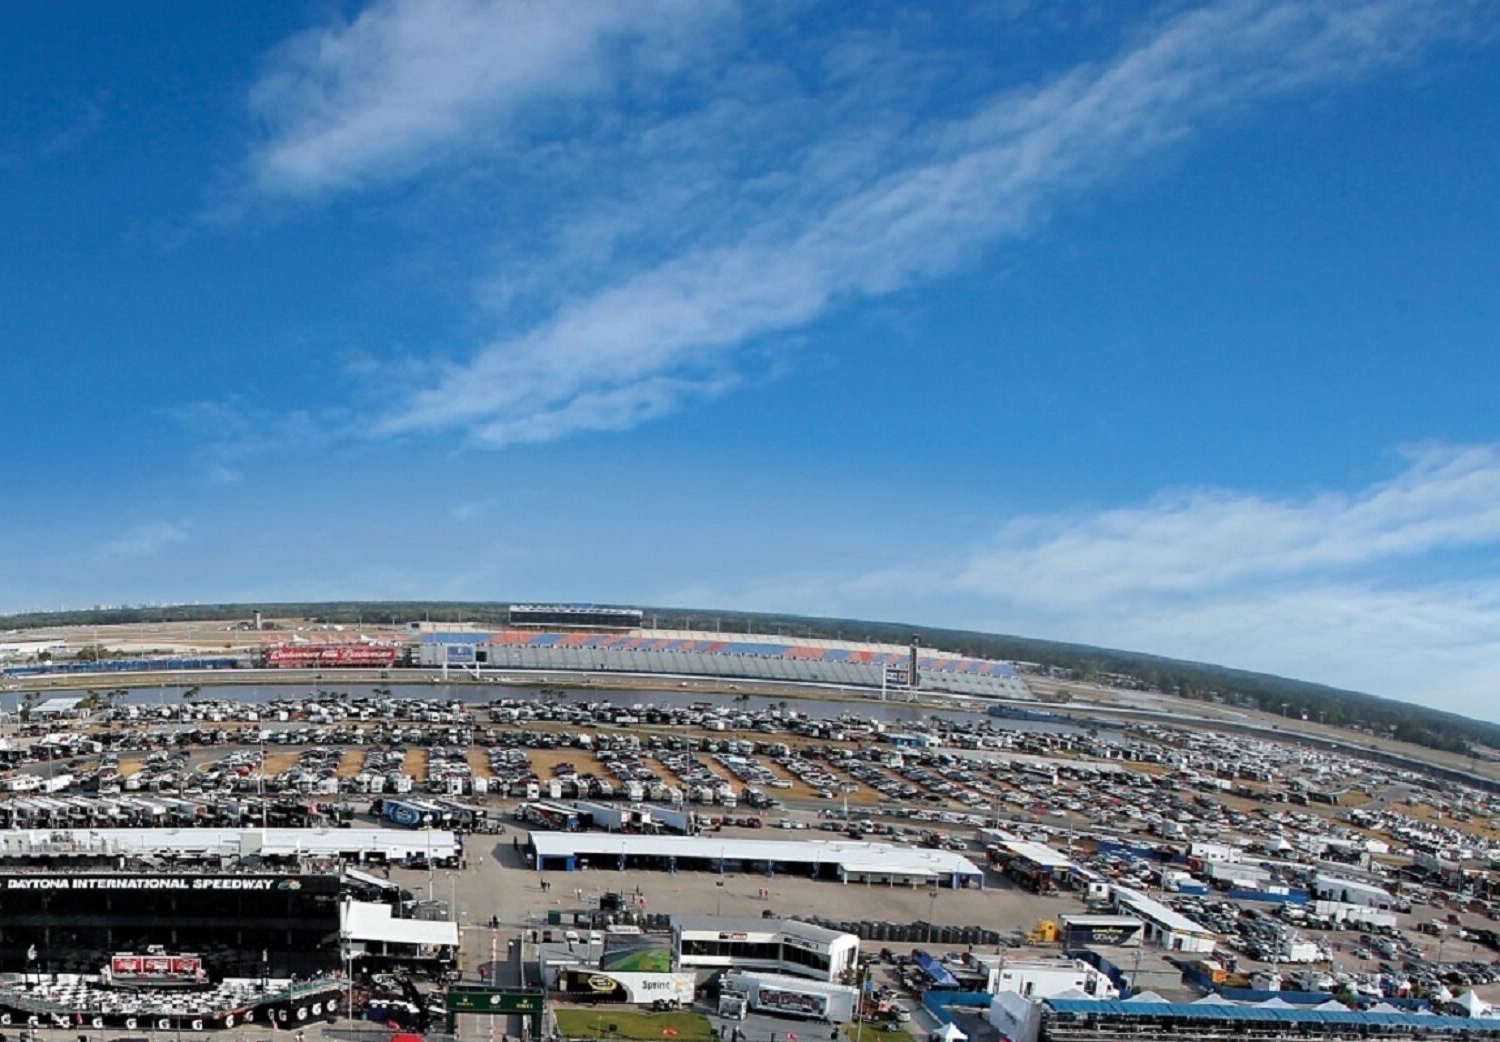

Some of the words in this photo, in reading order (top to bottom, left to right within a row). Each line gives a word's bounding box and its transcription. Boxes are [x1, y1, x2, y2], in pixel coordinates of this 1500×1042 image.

[7, 878, 70, 889] DAYTONA
[72, 879, 189, 889] INTERNATIONAL
[193, 879, 274, 890] SPEEDWAY
[642, 980, 670, 990] Sprint
[312, 1003, 322, 1015] G
[327, 999, 336, 1011] G
[1, 1014, 11, 1024] G
[245, 1010, 254, 1021] G
[279, 1009, 287, 1021] G
[297, 1007, 307, 1020] G
[93, 1017, 103, 1028] G
[127, 1018, 137, 1029] G
[159, 1018, 170, 1030] G
[192, 1019, 202, 1030] G
[226, 1015, 234, 1028] G
